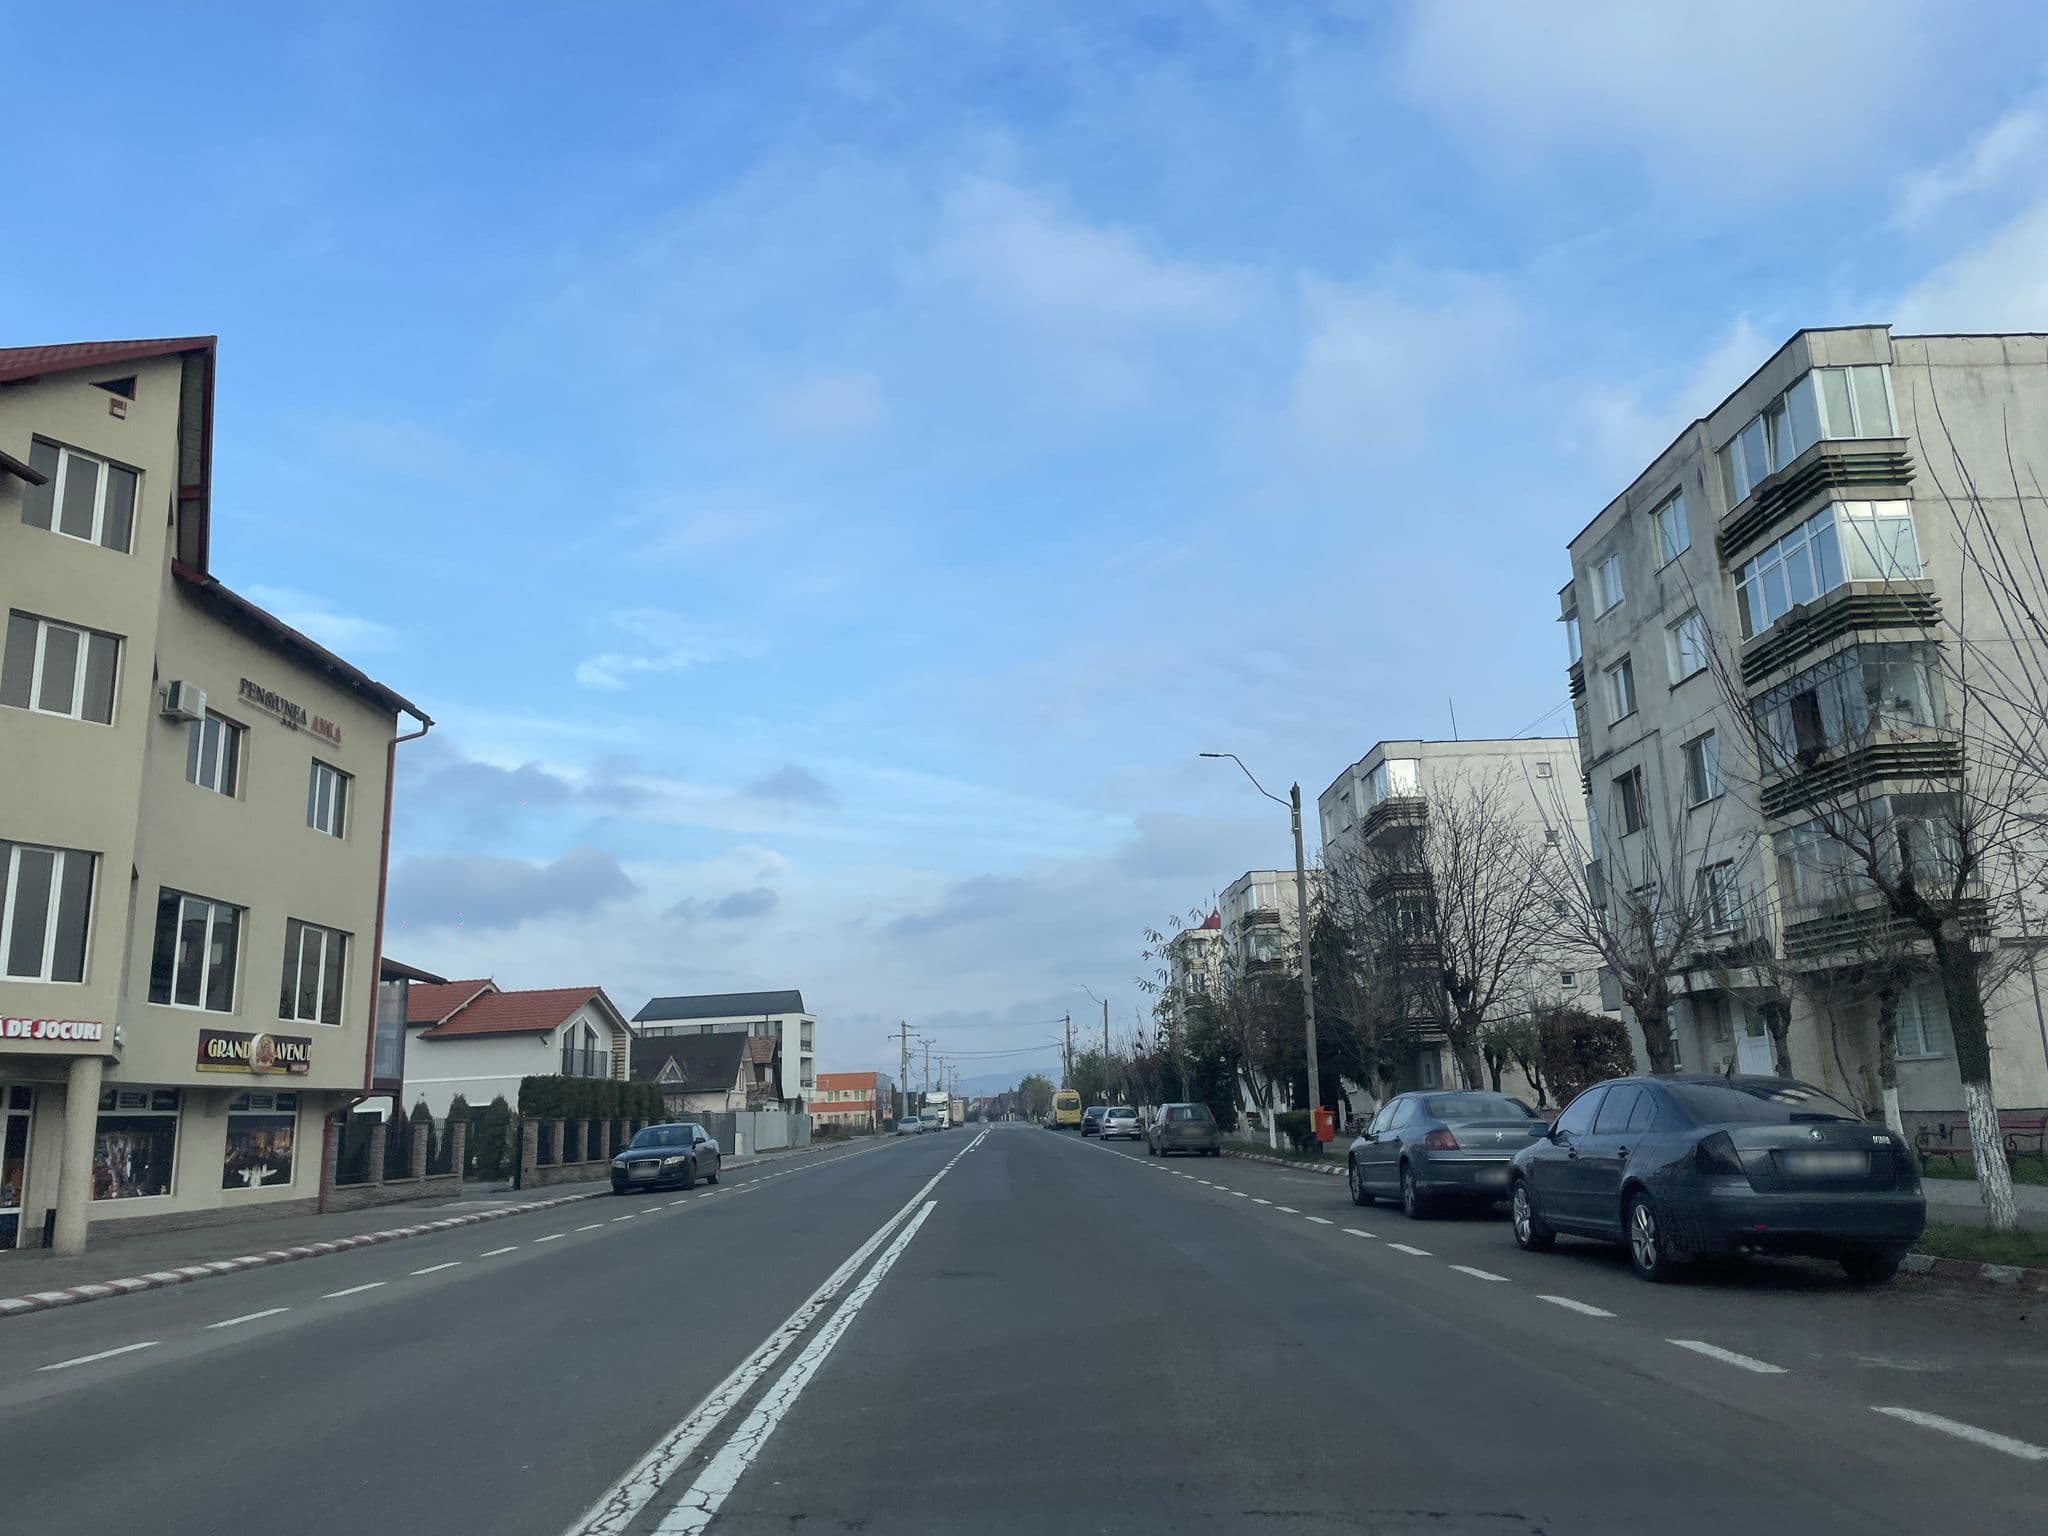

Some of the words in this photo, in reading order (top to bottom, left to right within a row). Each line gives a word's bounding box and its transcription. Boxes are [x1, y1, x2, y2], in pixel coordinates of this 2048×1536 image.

[239, 678, 307, 725] PENSIUNEA
[6, 1019, 33, 1038] DE
[33, 1020, 102, 1040] JOCURI
[207, 1038, 251, 1059] GRAND
[275, 1042, 312, 1061] AVENUE
